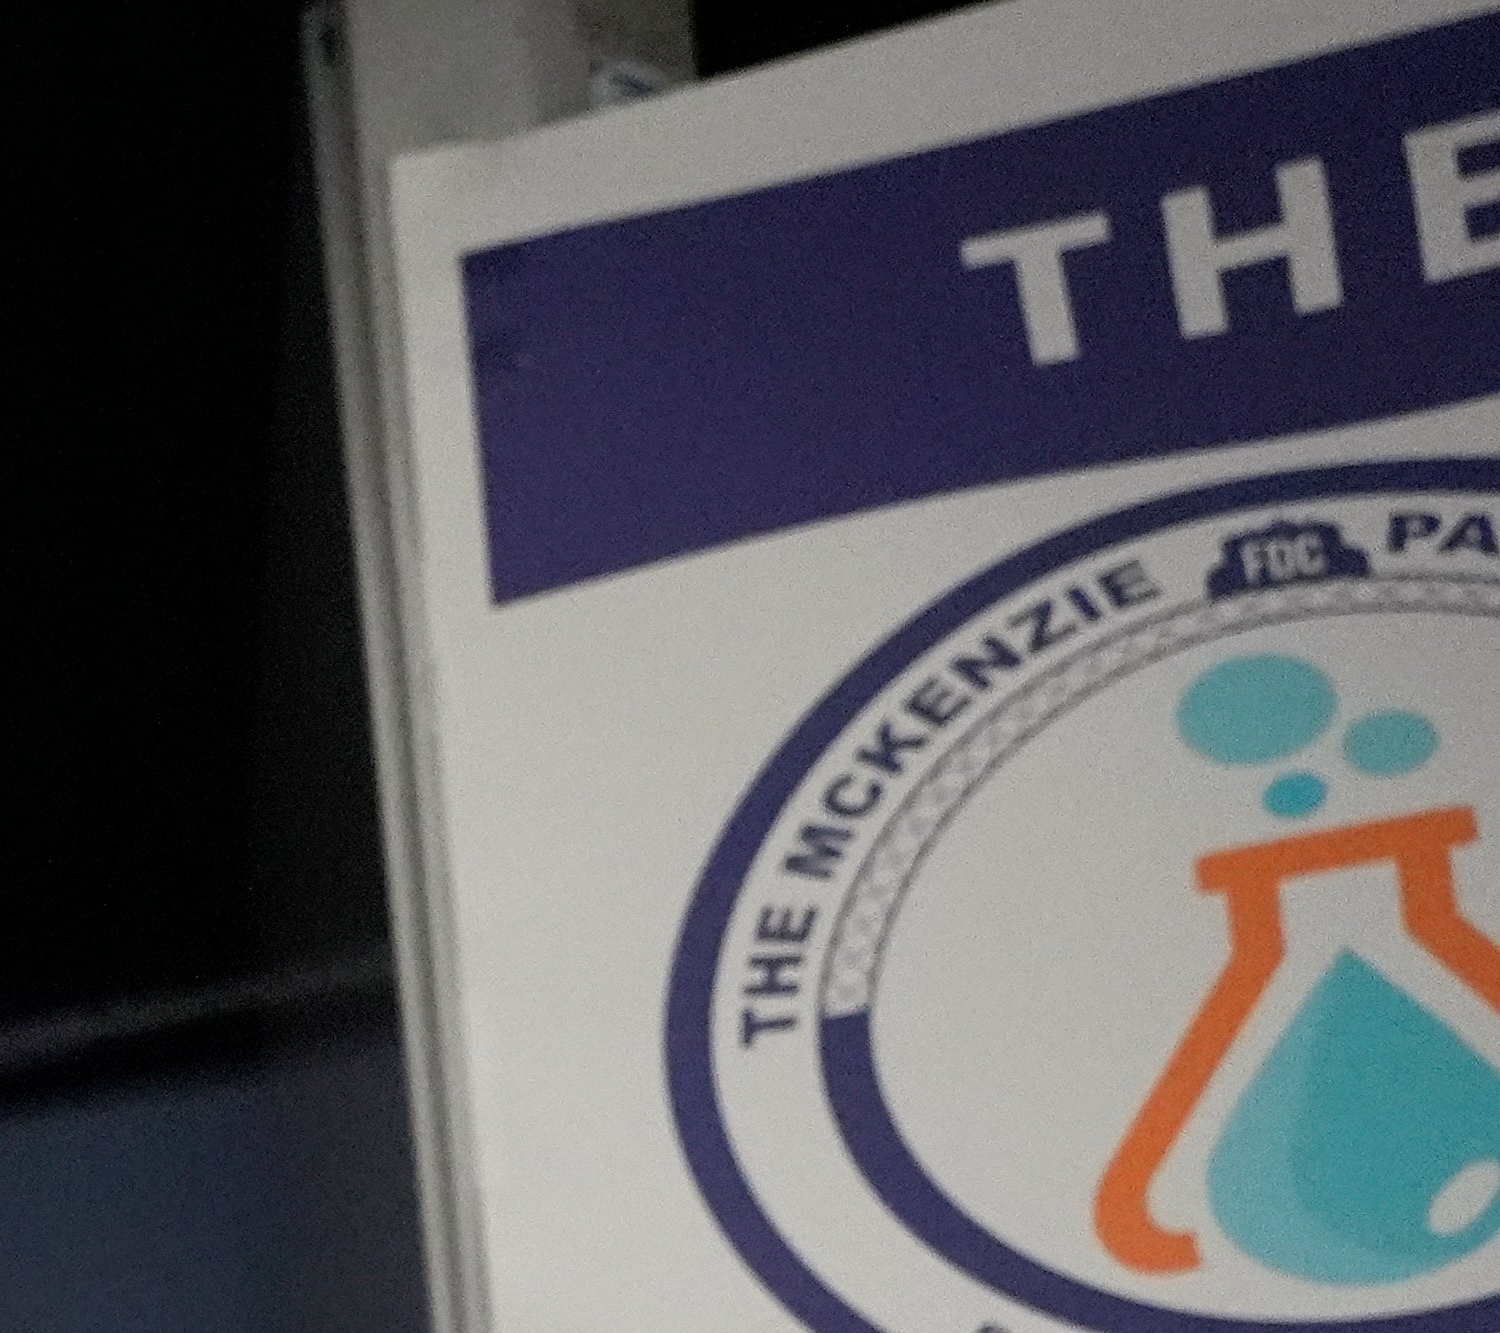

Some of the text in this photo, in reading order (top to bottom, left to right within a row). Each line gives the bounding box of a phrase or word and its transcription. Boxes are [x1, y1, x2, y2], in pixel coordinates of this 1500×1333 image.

[956, 106, 1500, 368] THE
[739, 510, 1500, 1050] THE MCKENZIE PA
